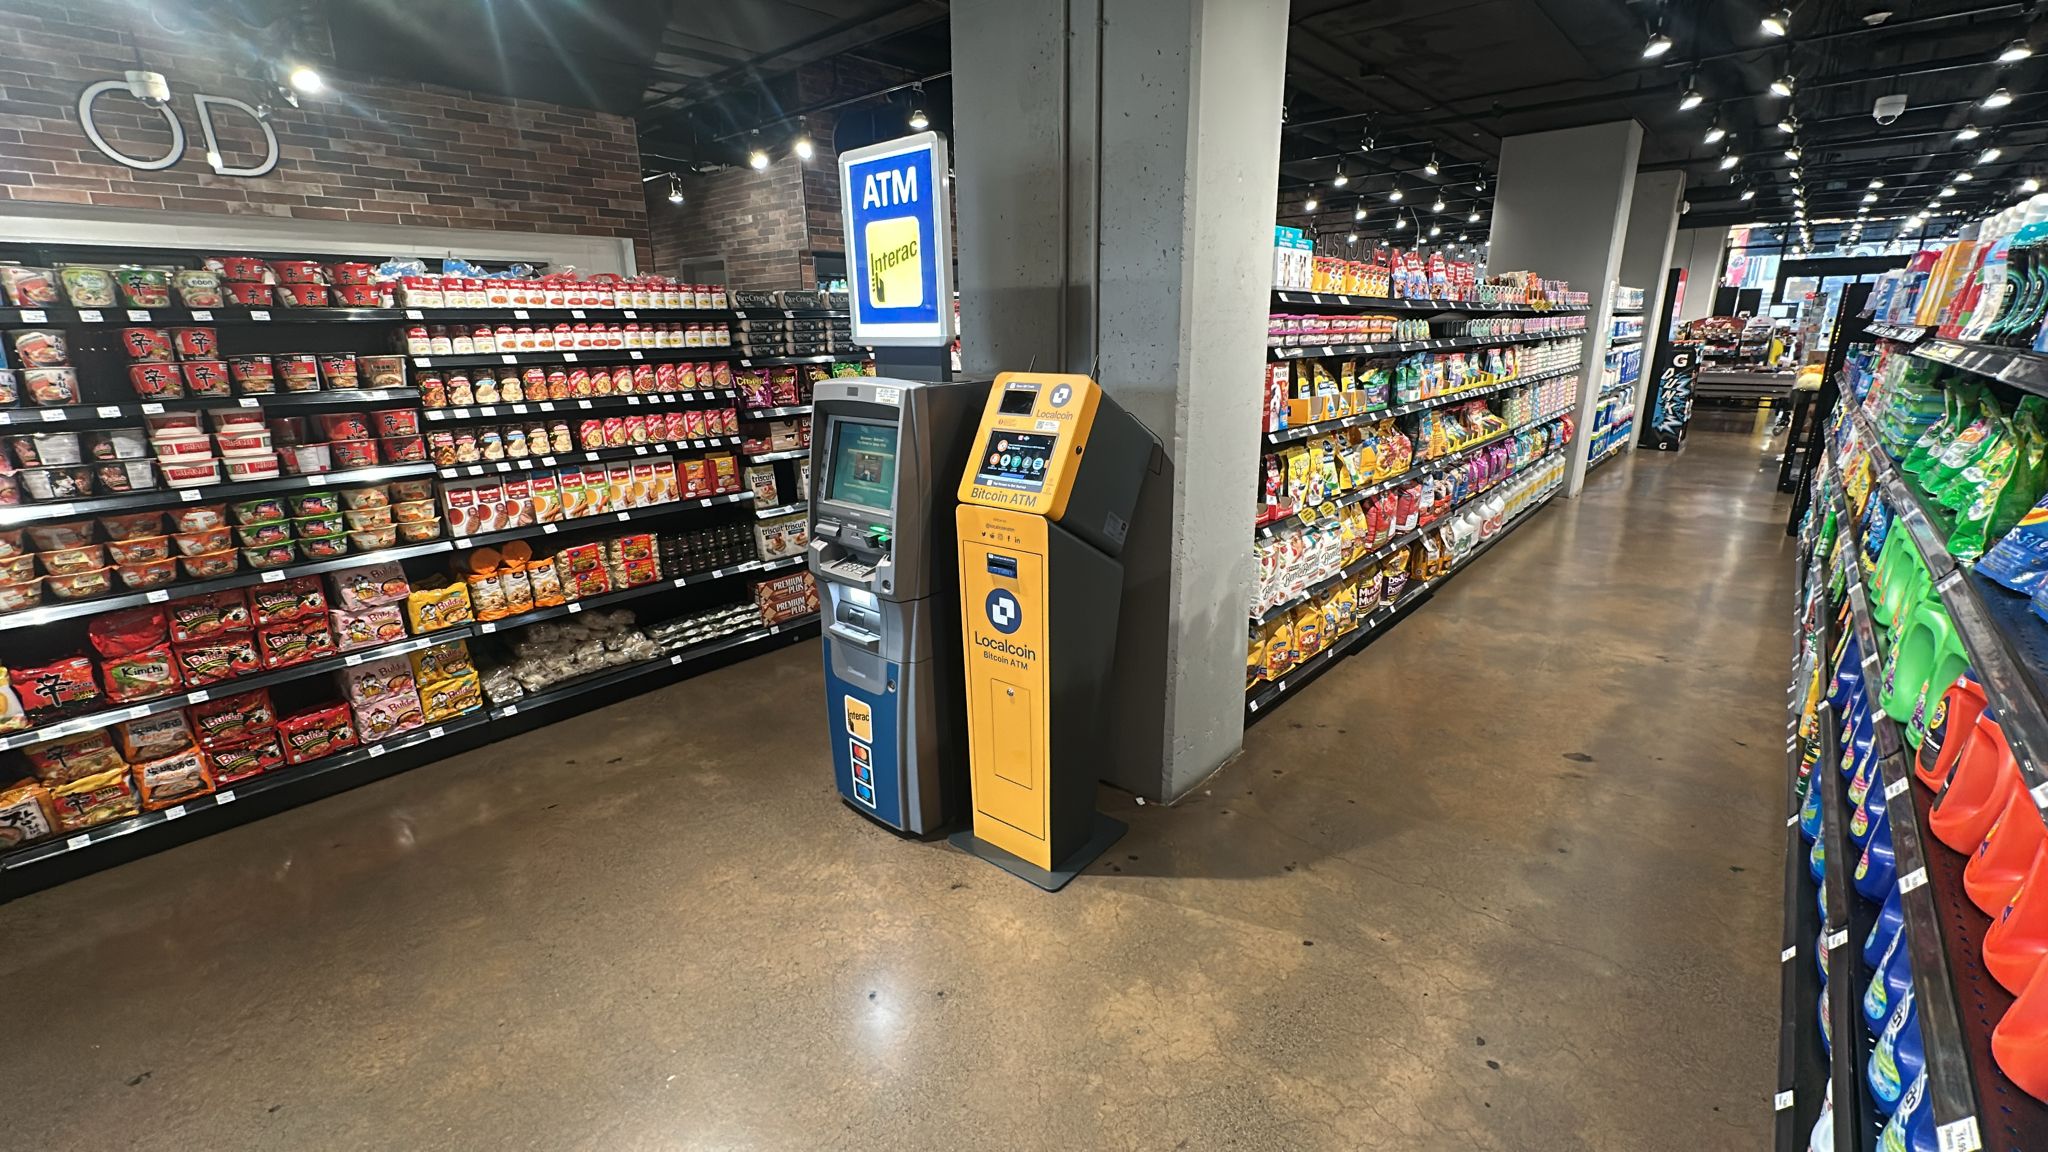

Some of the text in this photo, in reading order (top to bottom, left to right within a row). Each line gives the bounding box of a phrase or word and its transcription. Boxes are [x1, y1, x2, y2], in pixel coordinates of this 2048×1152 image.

[862, 166, 918, 210] ATM
[870, 238, 918, 276] Interac
[131, 333, 151, 354] 辛
[191, 332, 210, 352] 辛
[1672, 353, 1689, 368] G
[145, 369, 165, 389] 辛
[196, 367, 215, 387] 辛
[1036, 409, 1074, 421] Localcoin
[1658, 442, 1668, 450] G
[751, 473, 775, 482] triscuit
[970, 487, 1037, 507] Bitcoin ATM
[761, 525, 783, 536] triscuit
[785, 521, 806, 531] triscuit
[773, 575, 803, 591] PREMIUM
[788, 583, 804, 595] PLUS
[776, 596, 806, 612] PREMIUM
[791, 604, 807, 615] PLUS
[974, 630, 1036, 661] Localcoin
[983, 651, 1028, 670] Bitcoin ATM
[121, 664, 163, 678] Kimchi
[35, 673, 74, 707] 辛
[847, 708, 870, 721] Interac
